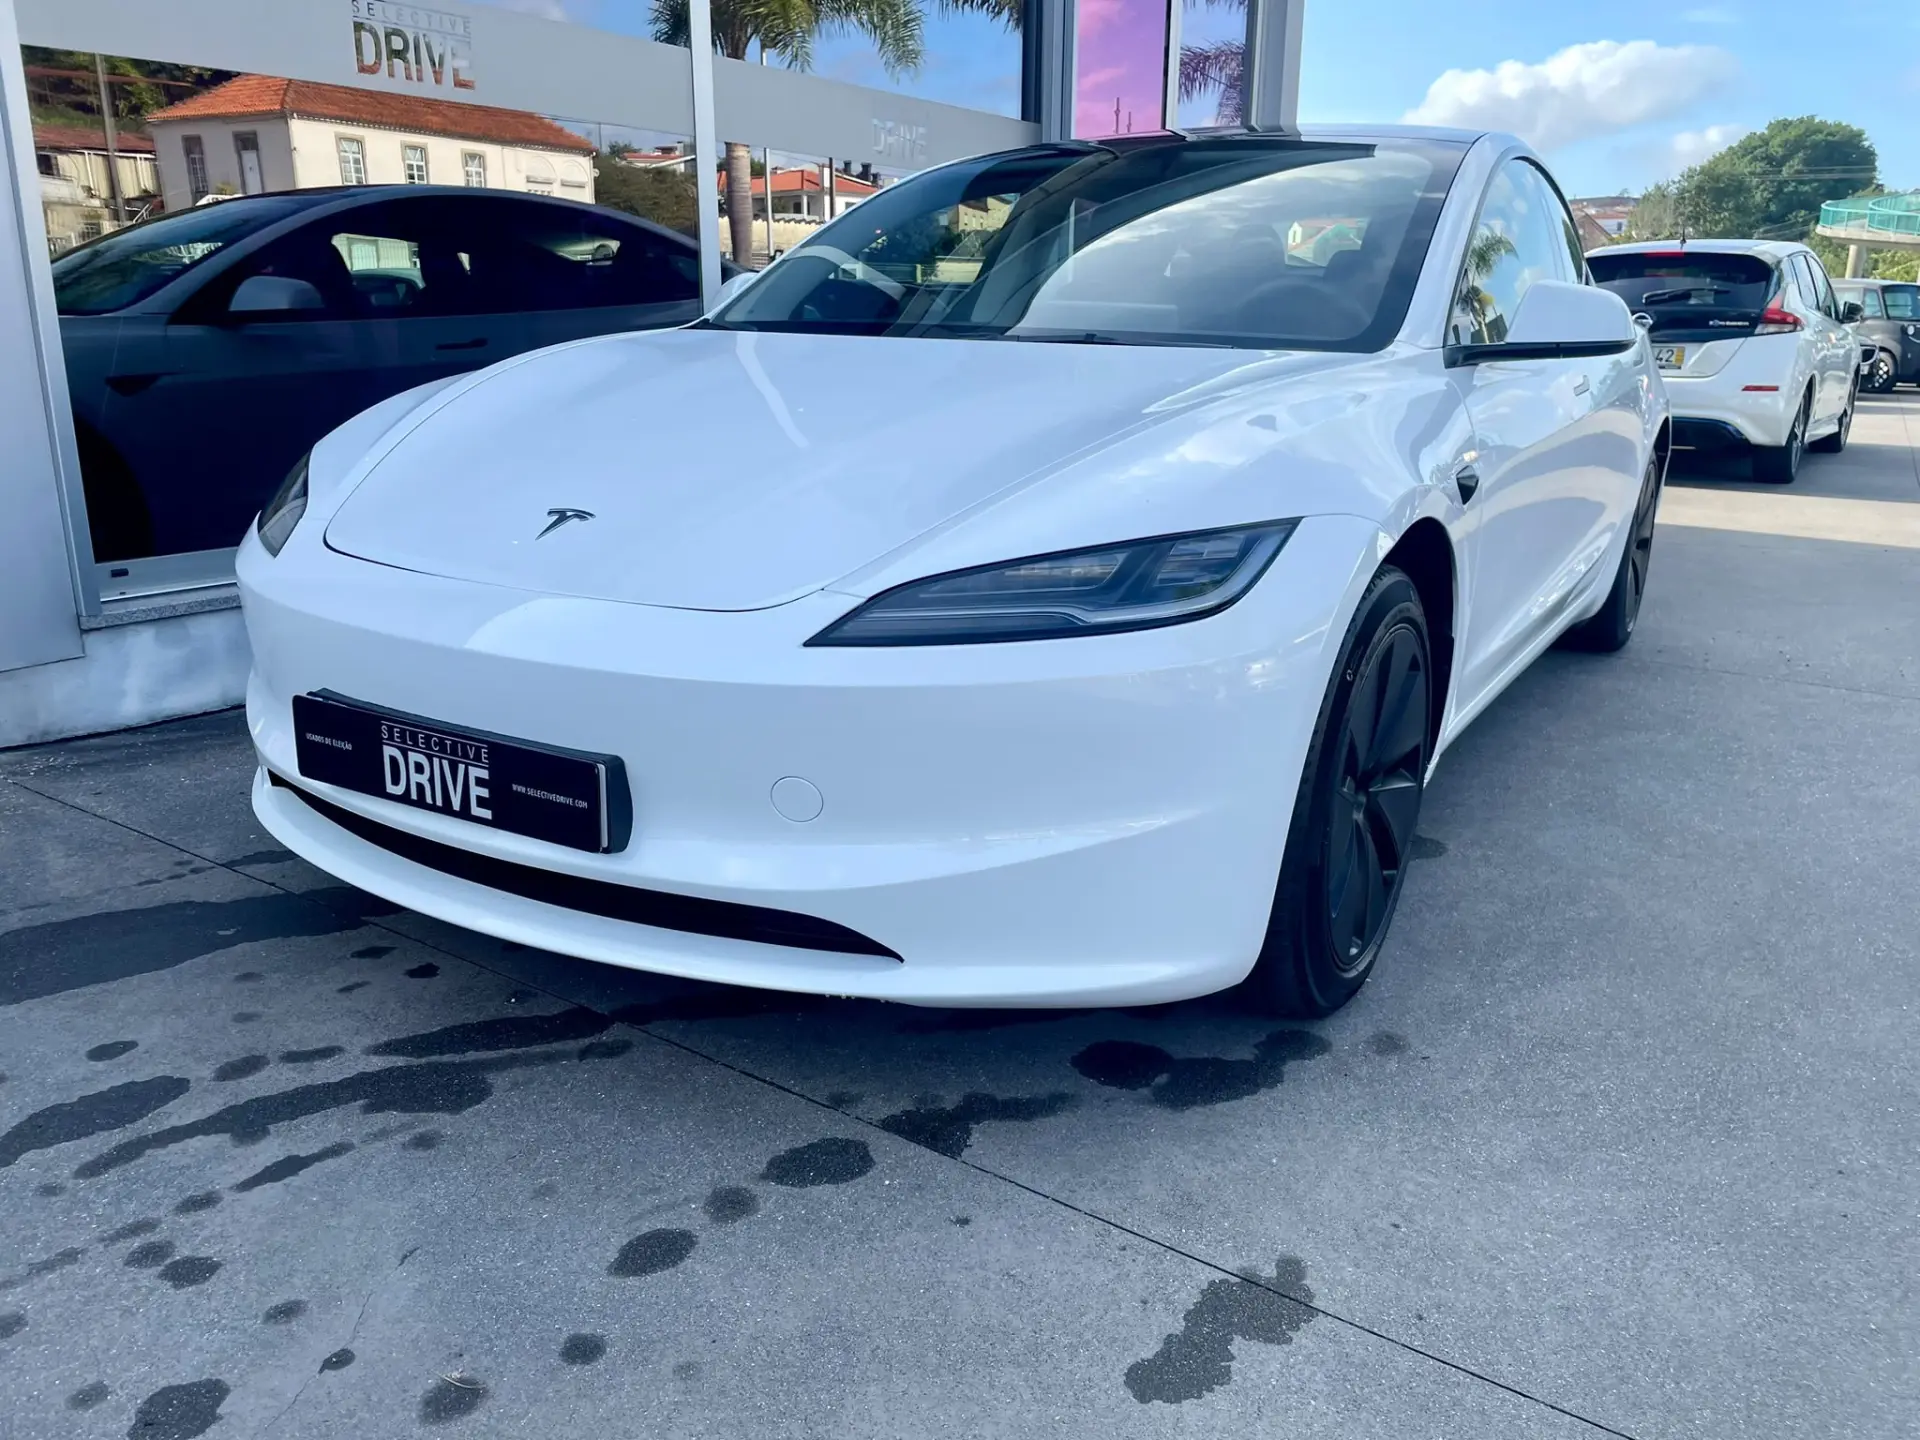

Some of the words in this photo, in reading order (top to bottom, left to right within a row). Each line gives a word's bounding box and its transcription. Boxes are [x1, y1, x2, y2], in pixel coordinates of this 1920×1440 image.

[350, 0, 472, 34] SELECTIVE
[353, 20, 476, 91] DRIVE
[381, 725, 489, 763] SELECTIVE
[382, 744, 493, 820] DRIVE
